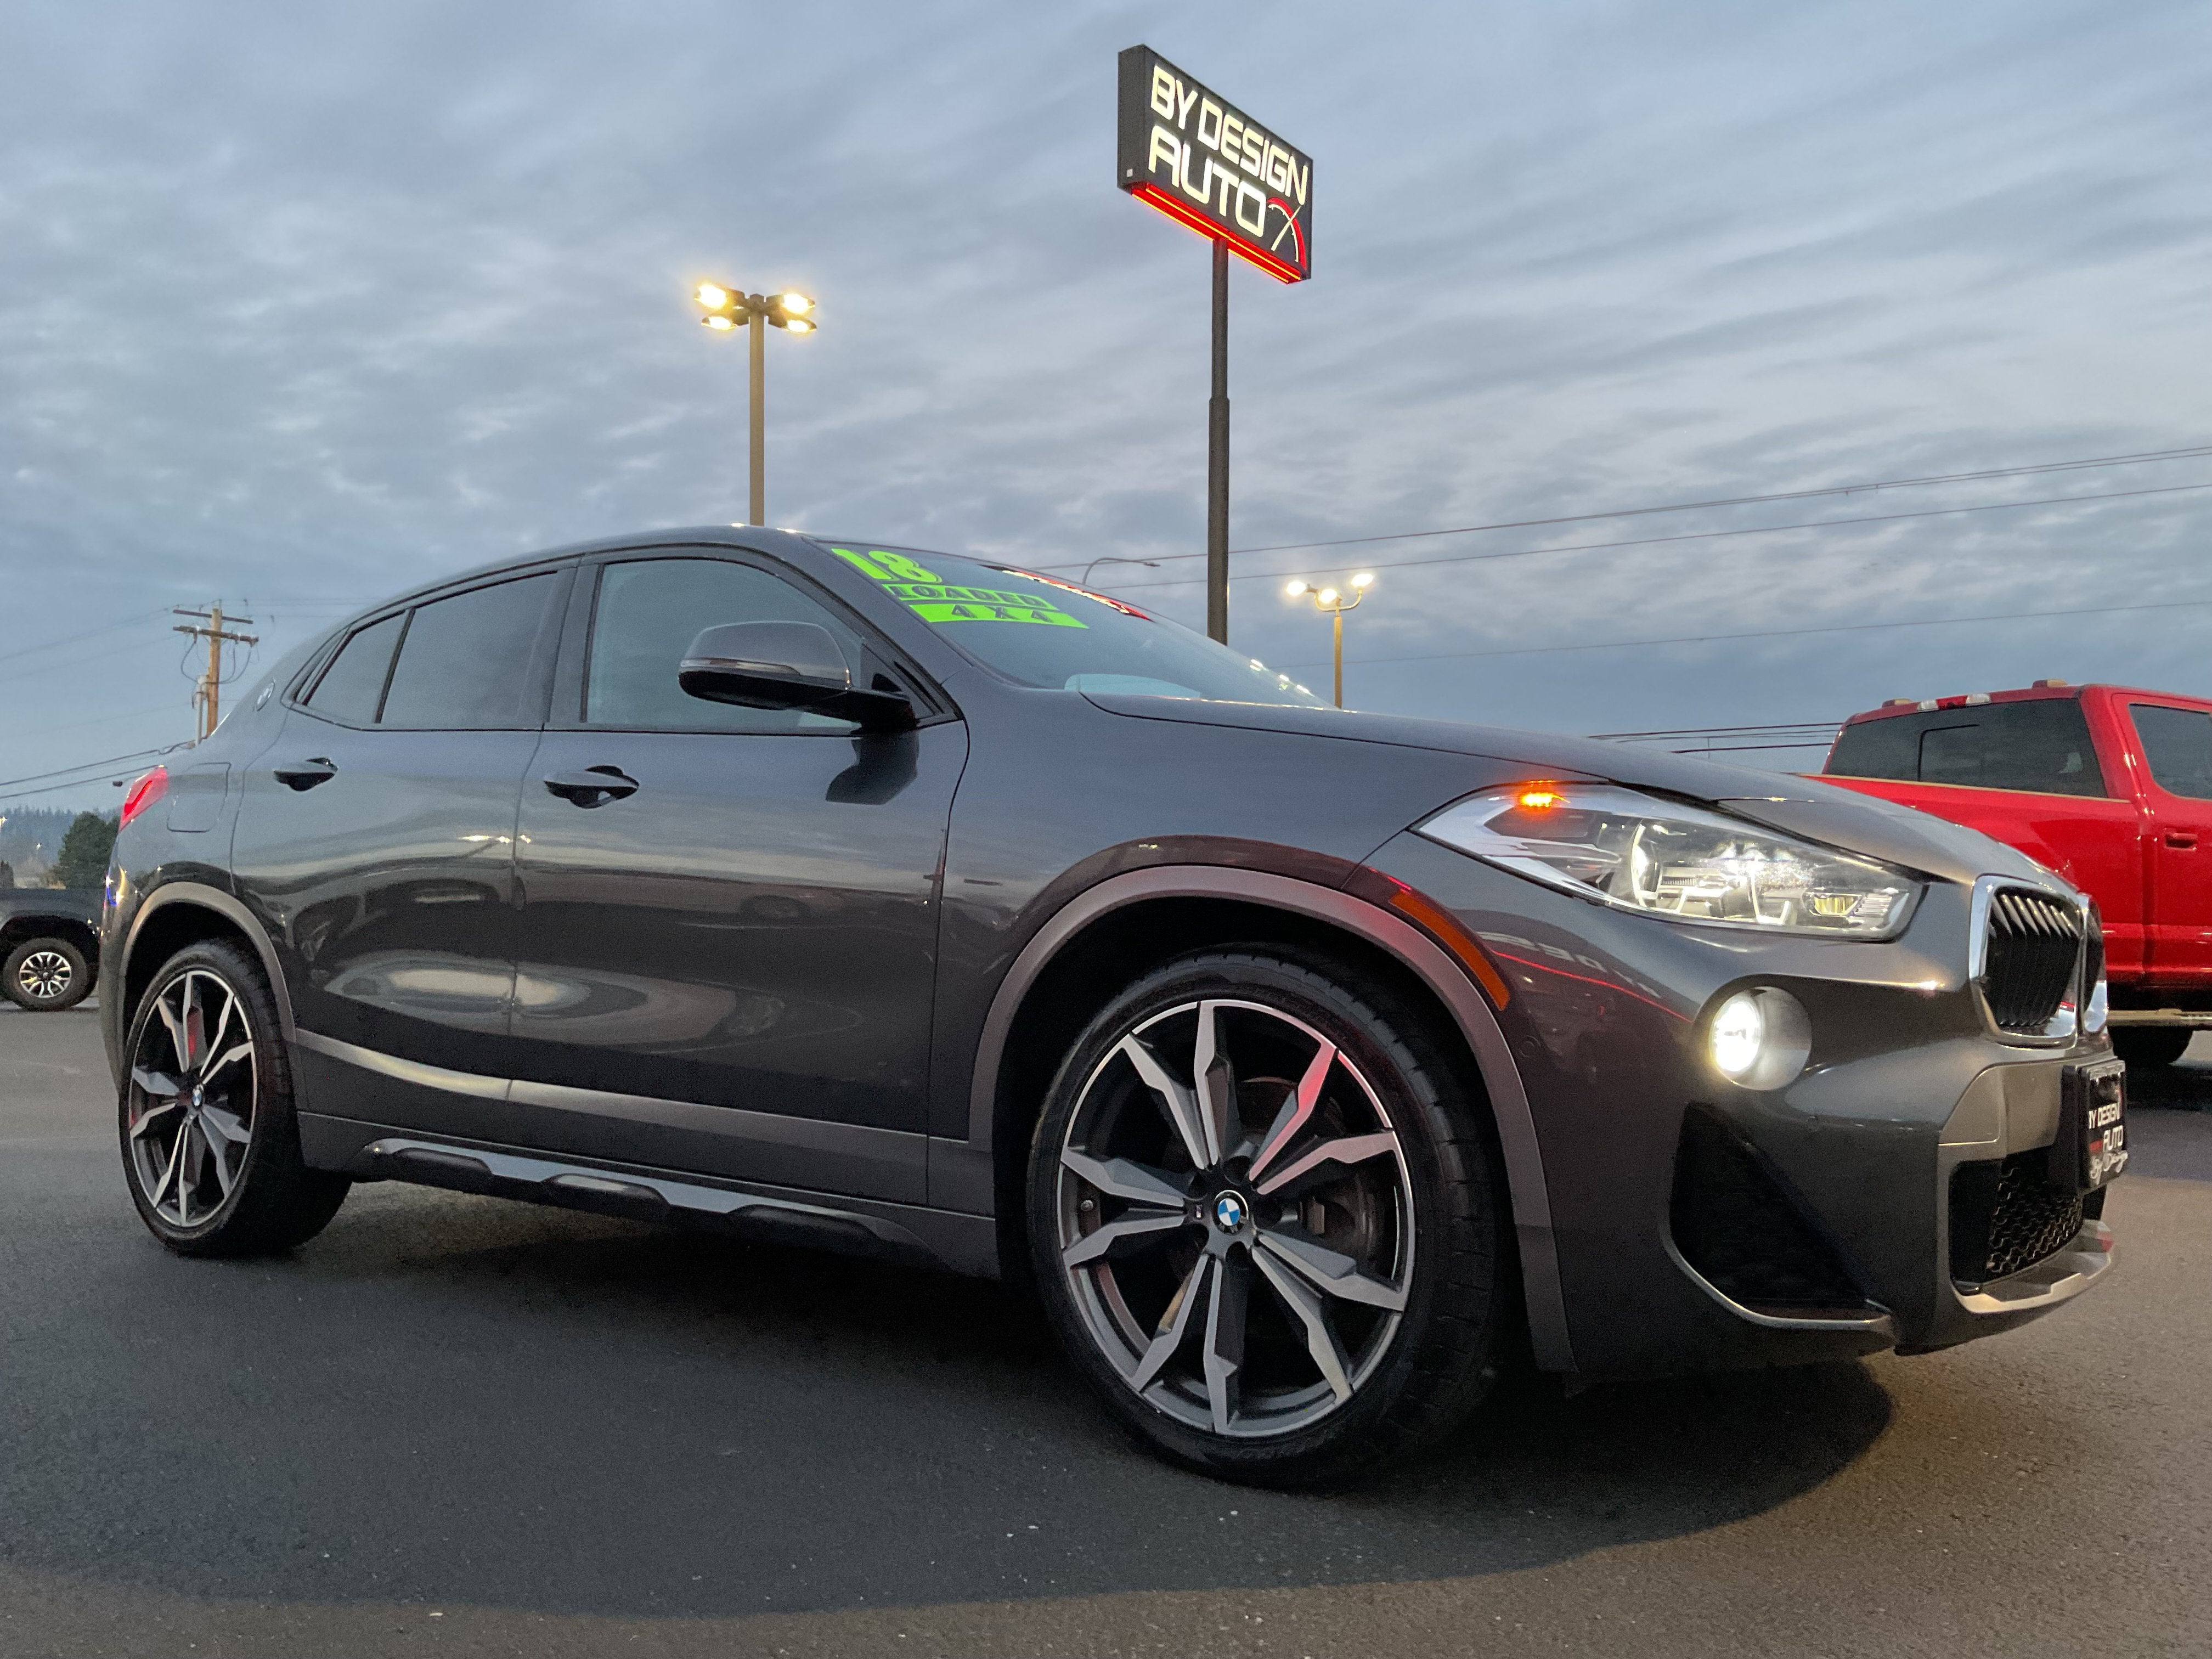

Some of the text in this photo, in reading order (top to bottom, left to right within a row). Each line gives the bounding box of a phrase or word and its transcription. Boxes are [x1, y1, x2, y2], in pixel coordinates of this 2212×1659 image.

[1150, 65, 1308, 205] BY DESIGN
[1148, 125, 1267, 238] AUTO
[831, 548, 943, 583] 18
[887, 584, 1048, 608] LOADED
[2103, 1125, 2123, 1152] AUTO
